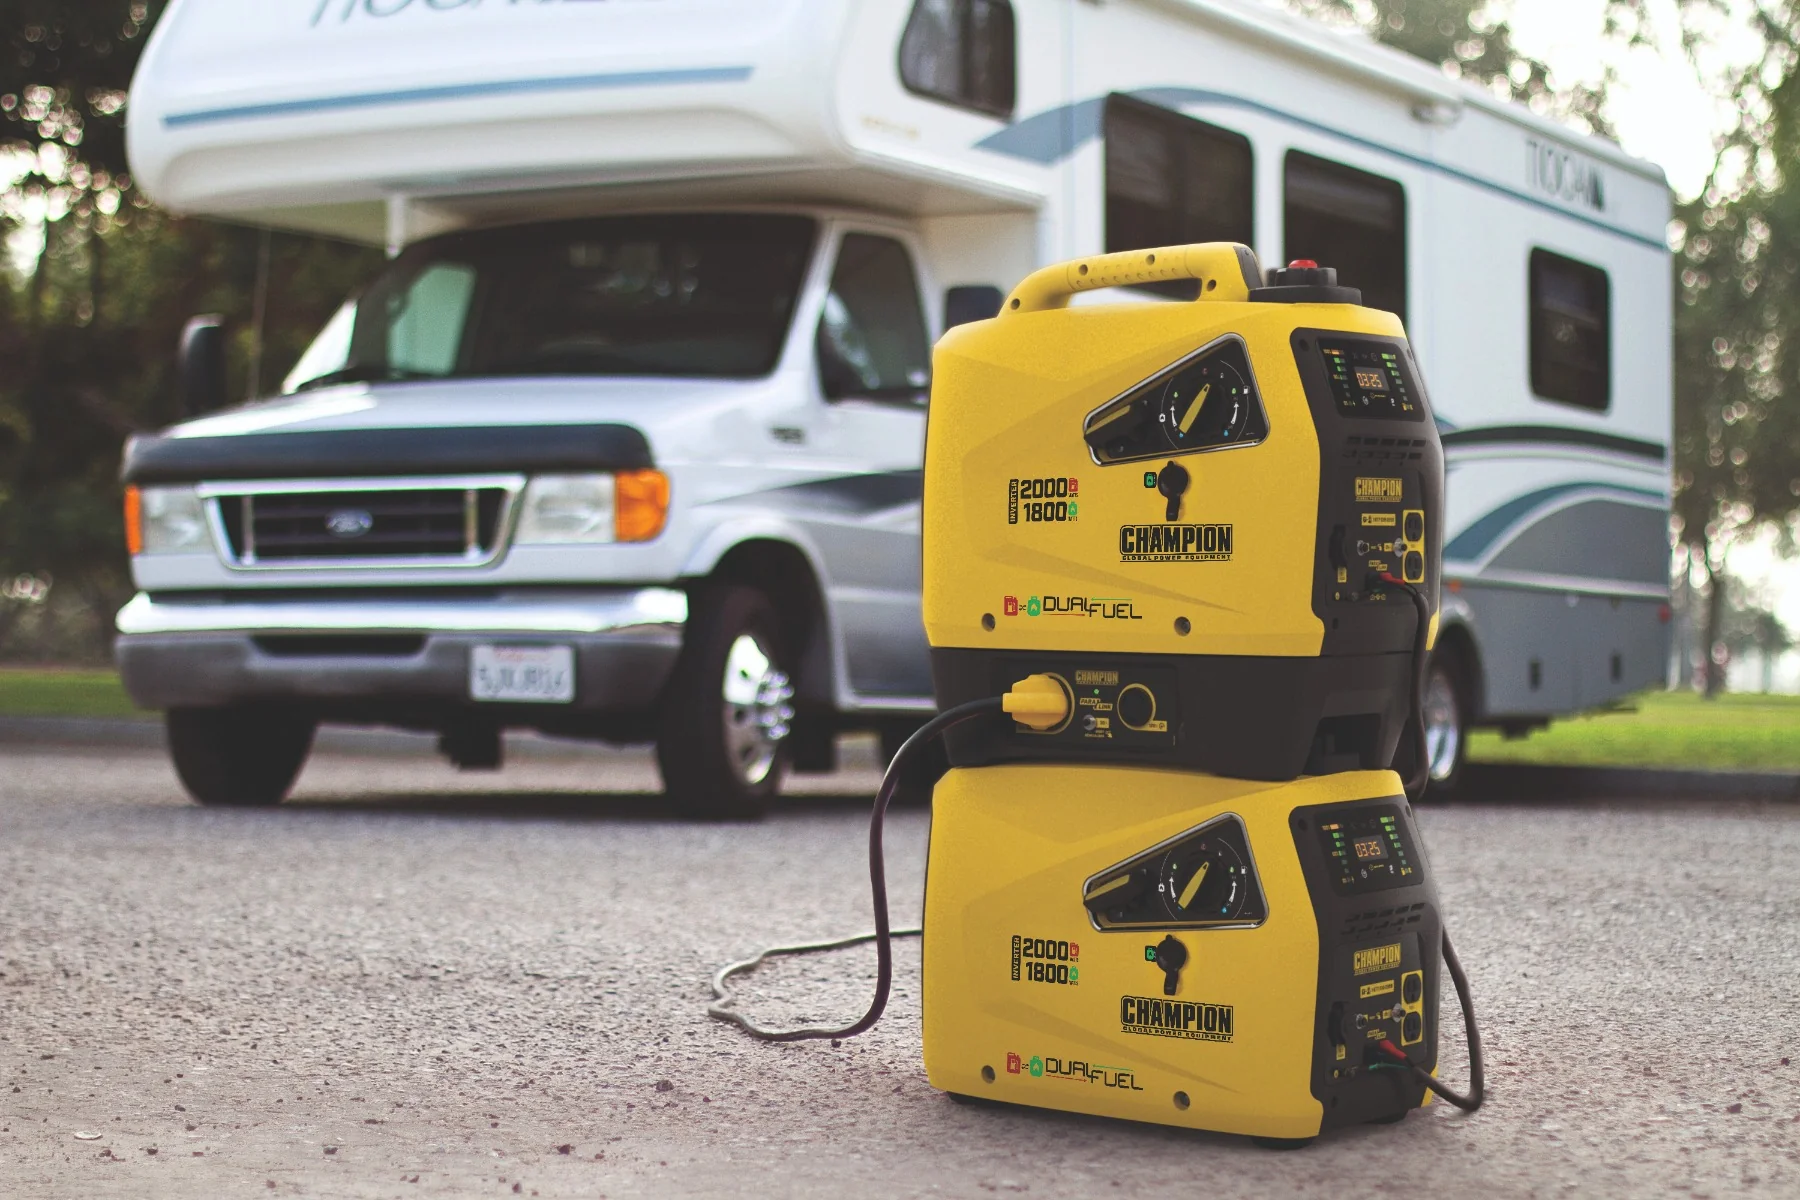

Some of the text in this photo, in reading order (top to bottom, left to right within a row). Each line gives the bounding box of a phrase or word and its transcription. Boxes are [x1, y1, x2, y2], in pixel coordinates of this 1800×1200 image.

[1020, 478, 1068, 499] 2000
[1355, 479, 1402, 497] CHAMPION
[1010, 479, 1018, 522] INVERTER
[1023, 501, 1068, 522] 1800
[1121, 525, 1232, 554] CHAMPION
[1043, 596, 1090, 612] DUAL
[1088, 603, 1142, 619] FUEL
[1075, 671, 1119, 682] CHAMPION
[1023, 938, 1068, 961] 2000
[1354, 944, 1401, 969] CHAMPION
[1025, 961, 1068, 984] 1800
[1121, 997, 1232, 1034] CHAMPION
[1122, 1026, 1232, 1042] GLOBAL POWER EQUIPMENT
[1045, 1057, 1091, 1078] DUAL
[1088, 1070, 1143, 1090] FUEL
